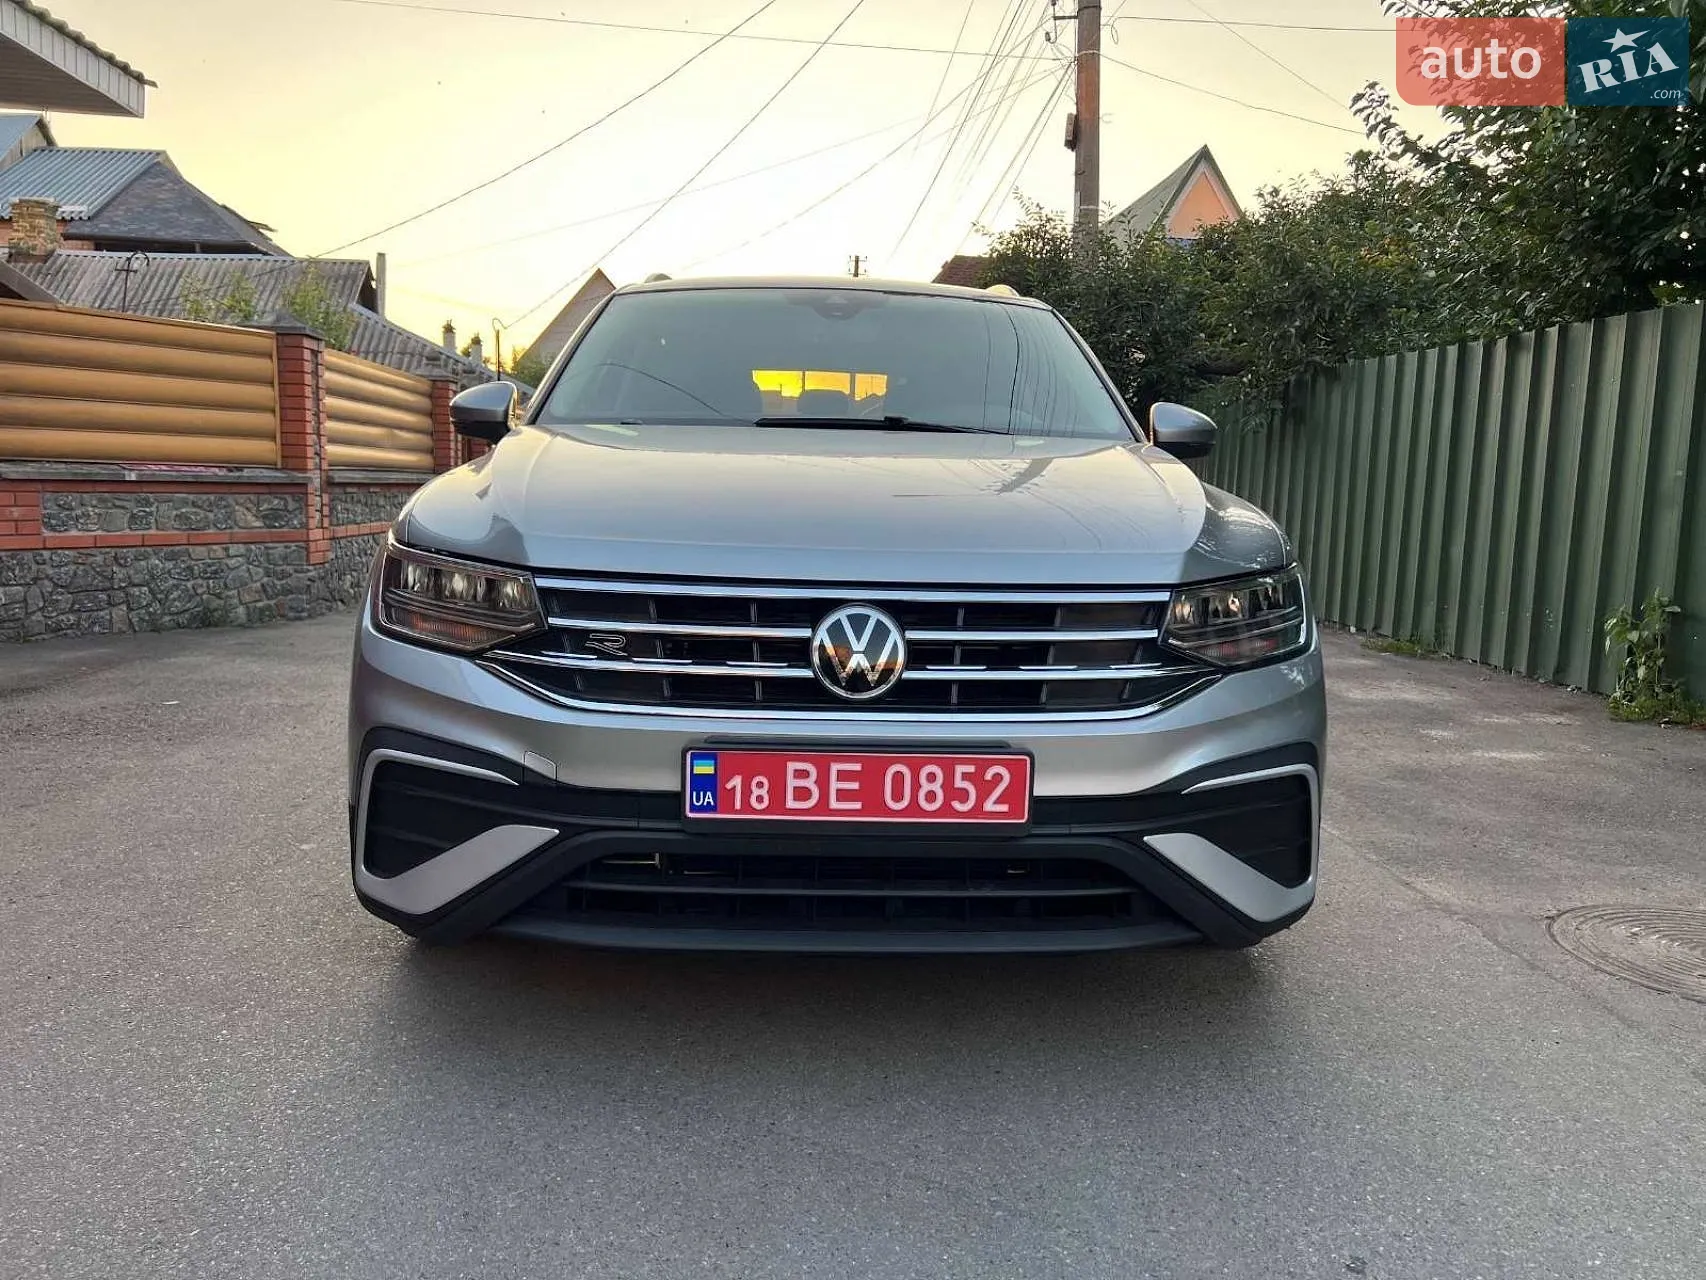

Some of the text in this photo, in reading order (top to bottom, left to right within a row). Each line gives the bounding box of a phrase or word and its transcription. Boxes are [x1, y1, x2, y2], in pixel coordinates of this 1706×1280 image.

[692, 790, 714, 806] UA
[725, 761, 1010, 813] 18 BE 0852
